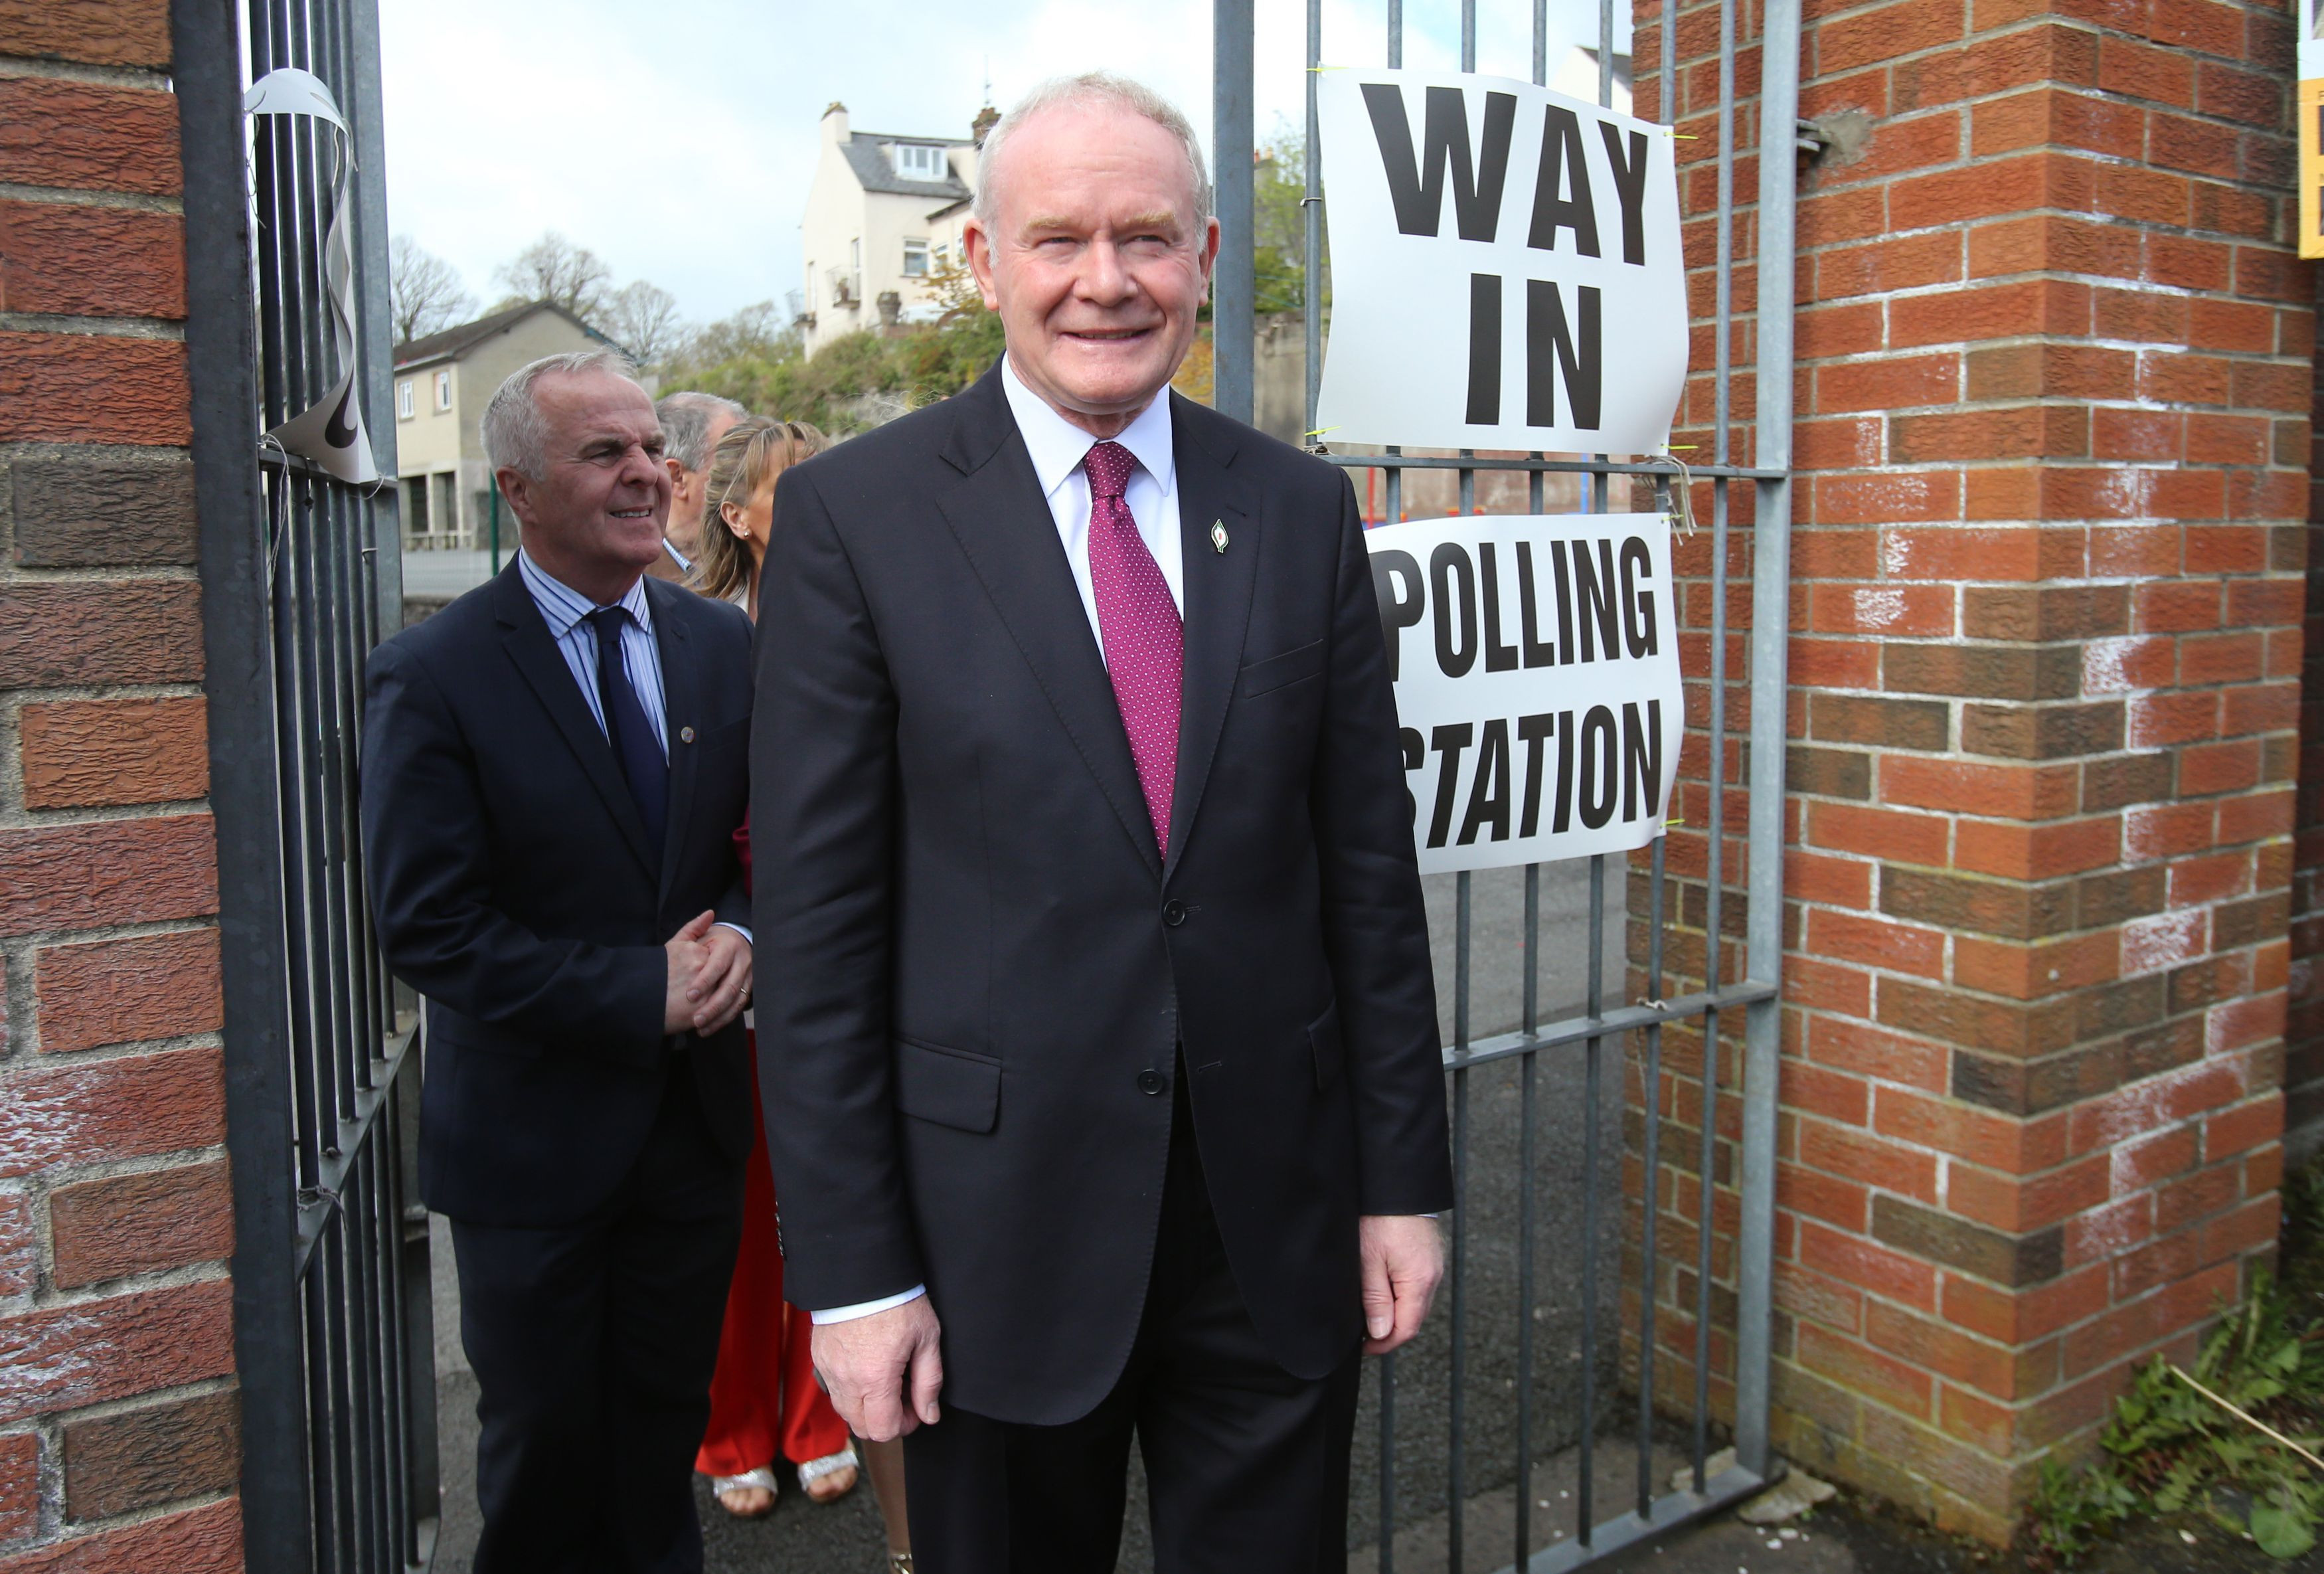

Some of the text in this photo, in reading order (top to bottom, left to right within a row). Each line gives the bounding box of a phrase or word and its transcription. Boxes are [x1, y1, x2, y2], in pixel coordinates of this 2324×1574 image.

[1360, 84, 1648, 266] WAY
[1465, 273, 1601, 430] IN
[1368, 537, 1658, 682] POLLING
